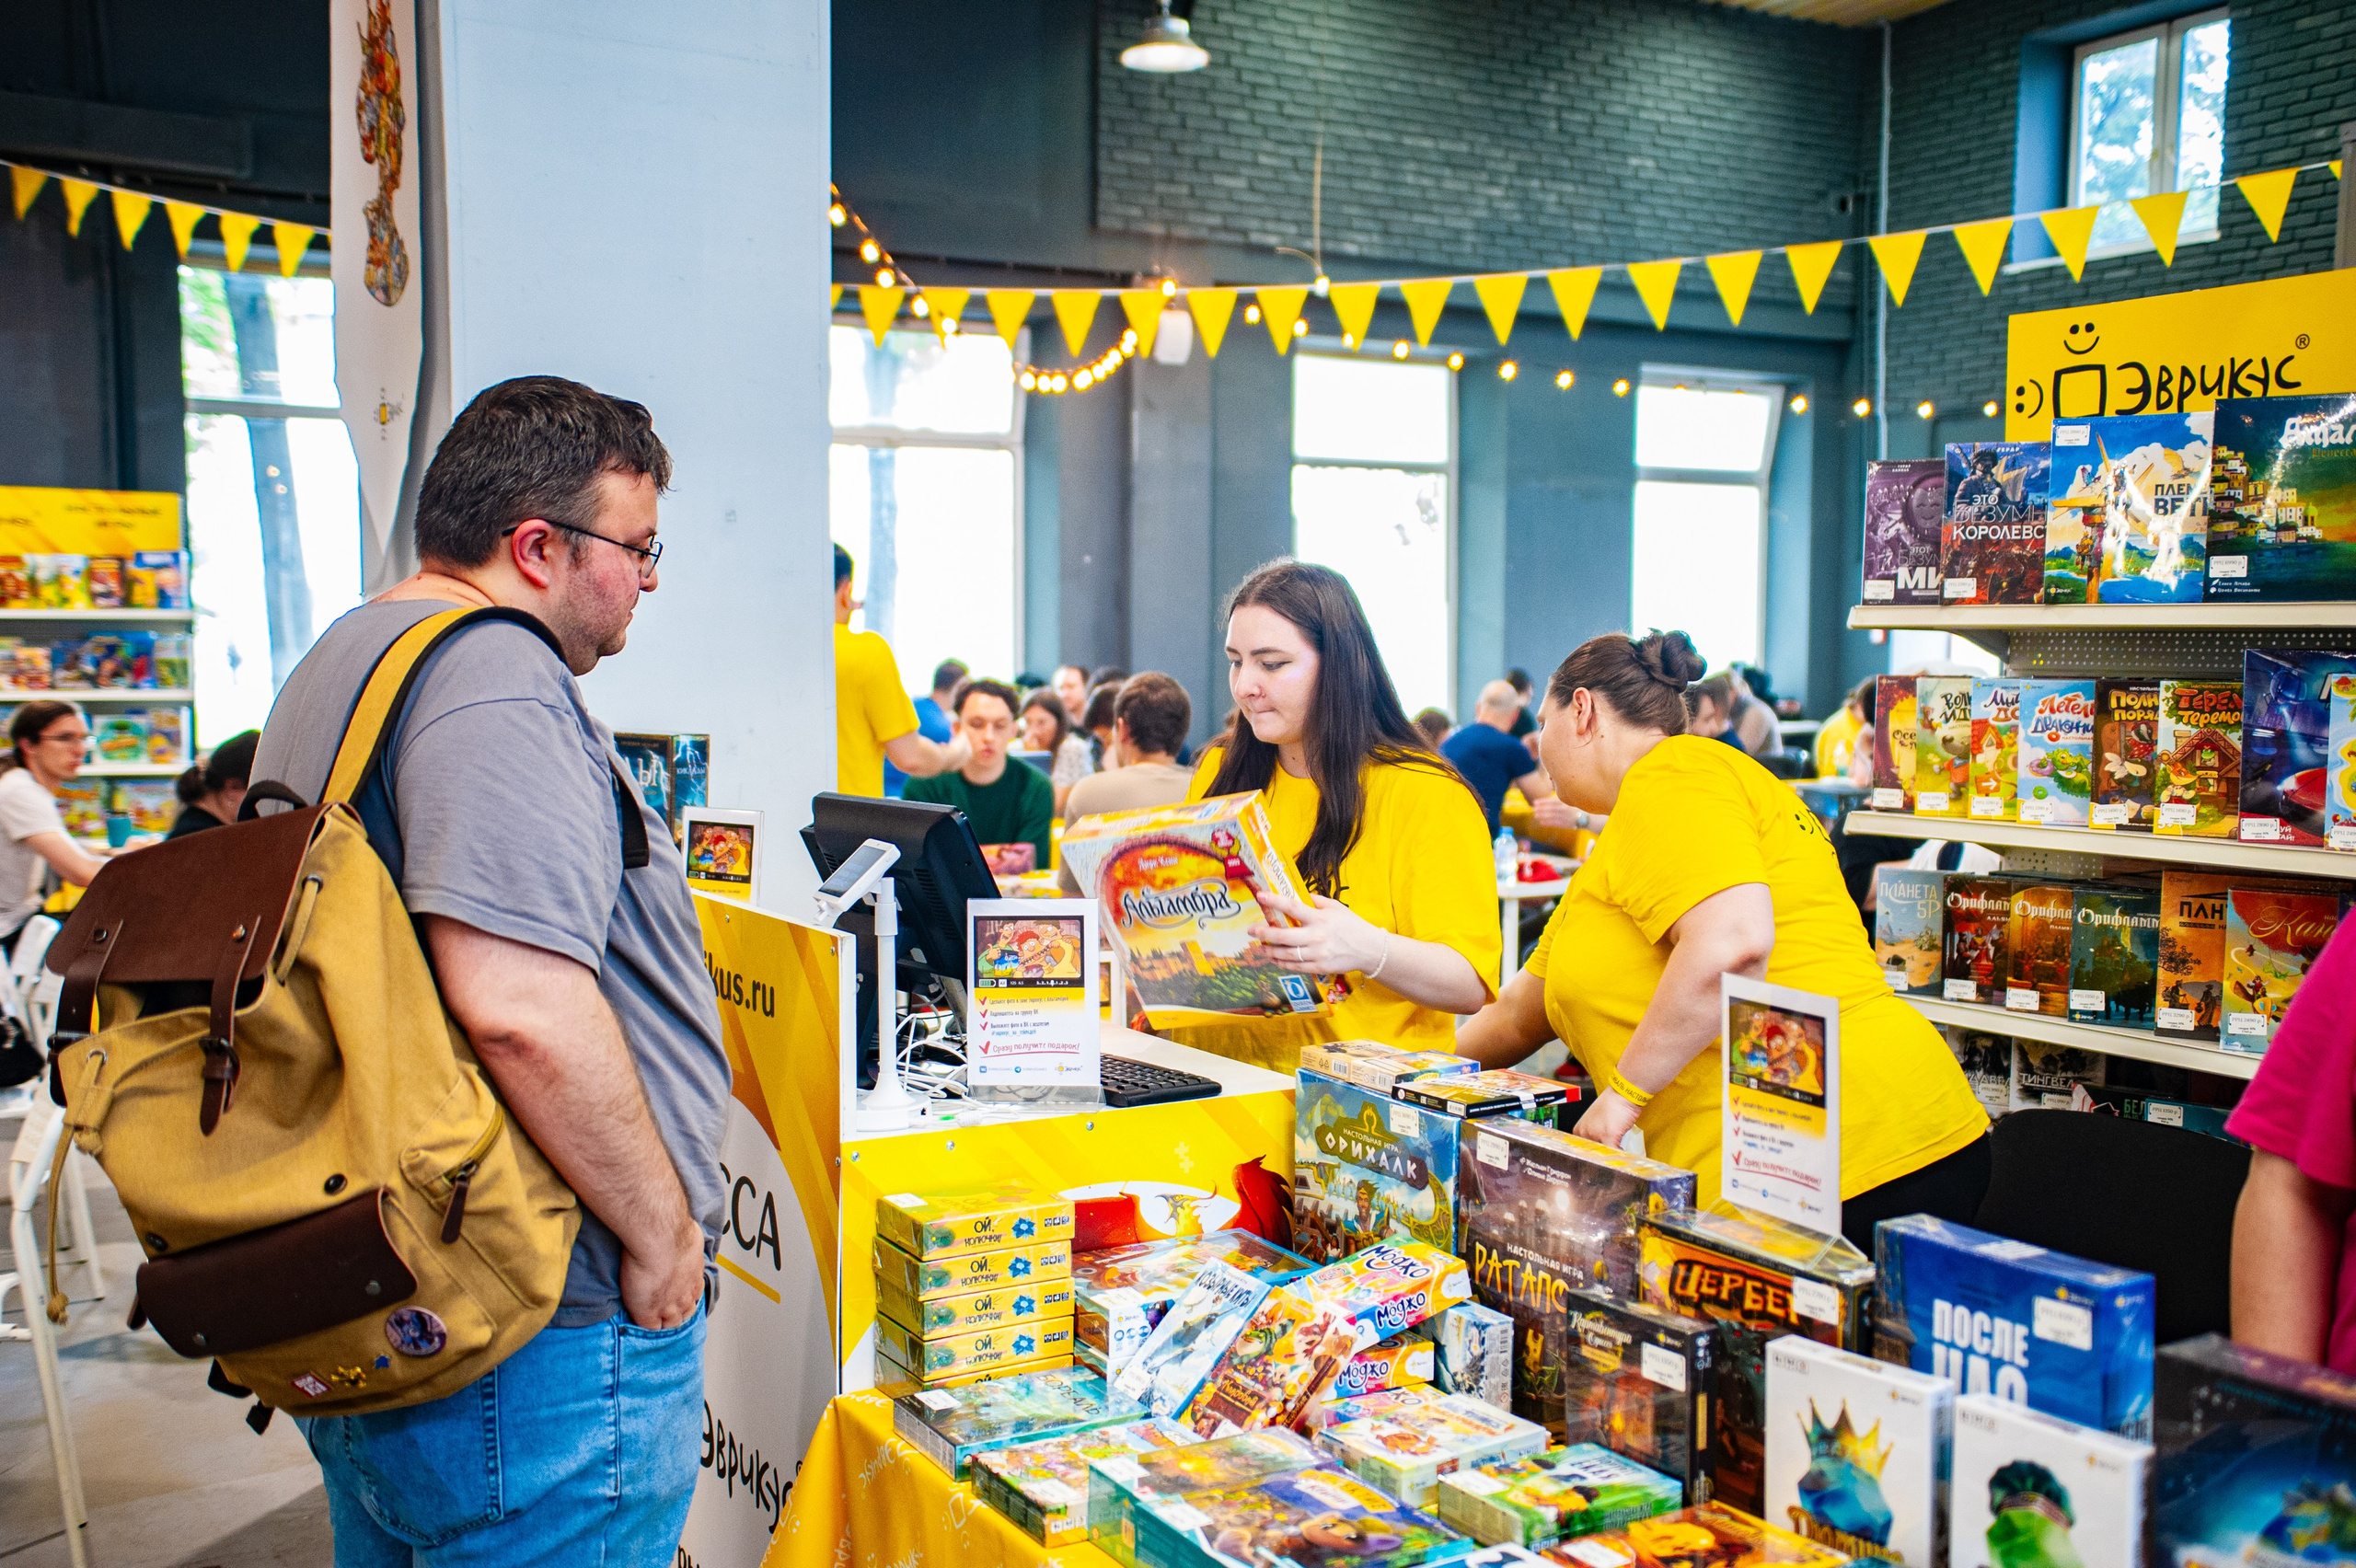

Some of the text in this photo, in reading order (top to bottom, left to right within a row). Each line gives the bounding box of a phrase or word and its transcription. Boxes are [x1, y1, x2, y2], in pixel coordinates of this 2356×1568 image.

[1972, 494, 1999, 505] ЭТО
[1953, 505, 2047, 524] БЕЗУМН
[1897, 567, 1944, 589] МИ
[1892, 730, 1917, 741] Осе
[1122, 881, 1239, 929] Альгамбра
[2015, 899, 2073, 921] Орифла
[992, 1042, 1080, 1054] Сразу получите подарок!
[1343, 1127, 1400, 1154] НАСТОЛЬНАЯ ИГРА
[1325, 1132, 1417, 1181] ОРИХАЛК
[1507, 1242, 1584, 1280] НАСТОЛЬНАЯ ИГРА
[1933, 1298, 2029, 1368] ПОСЛЕ
